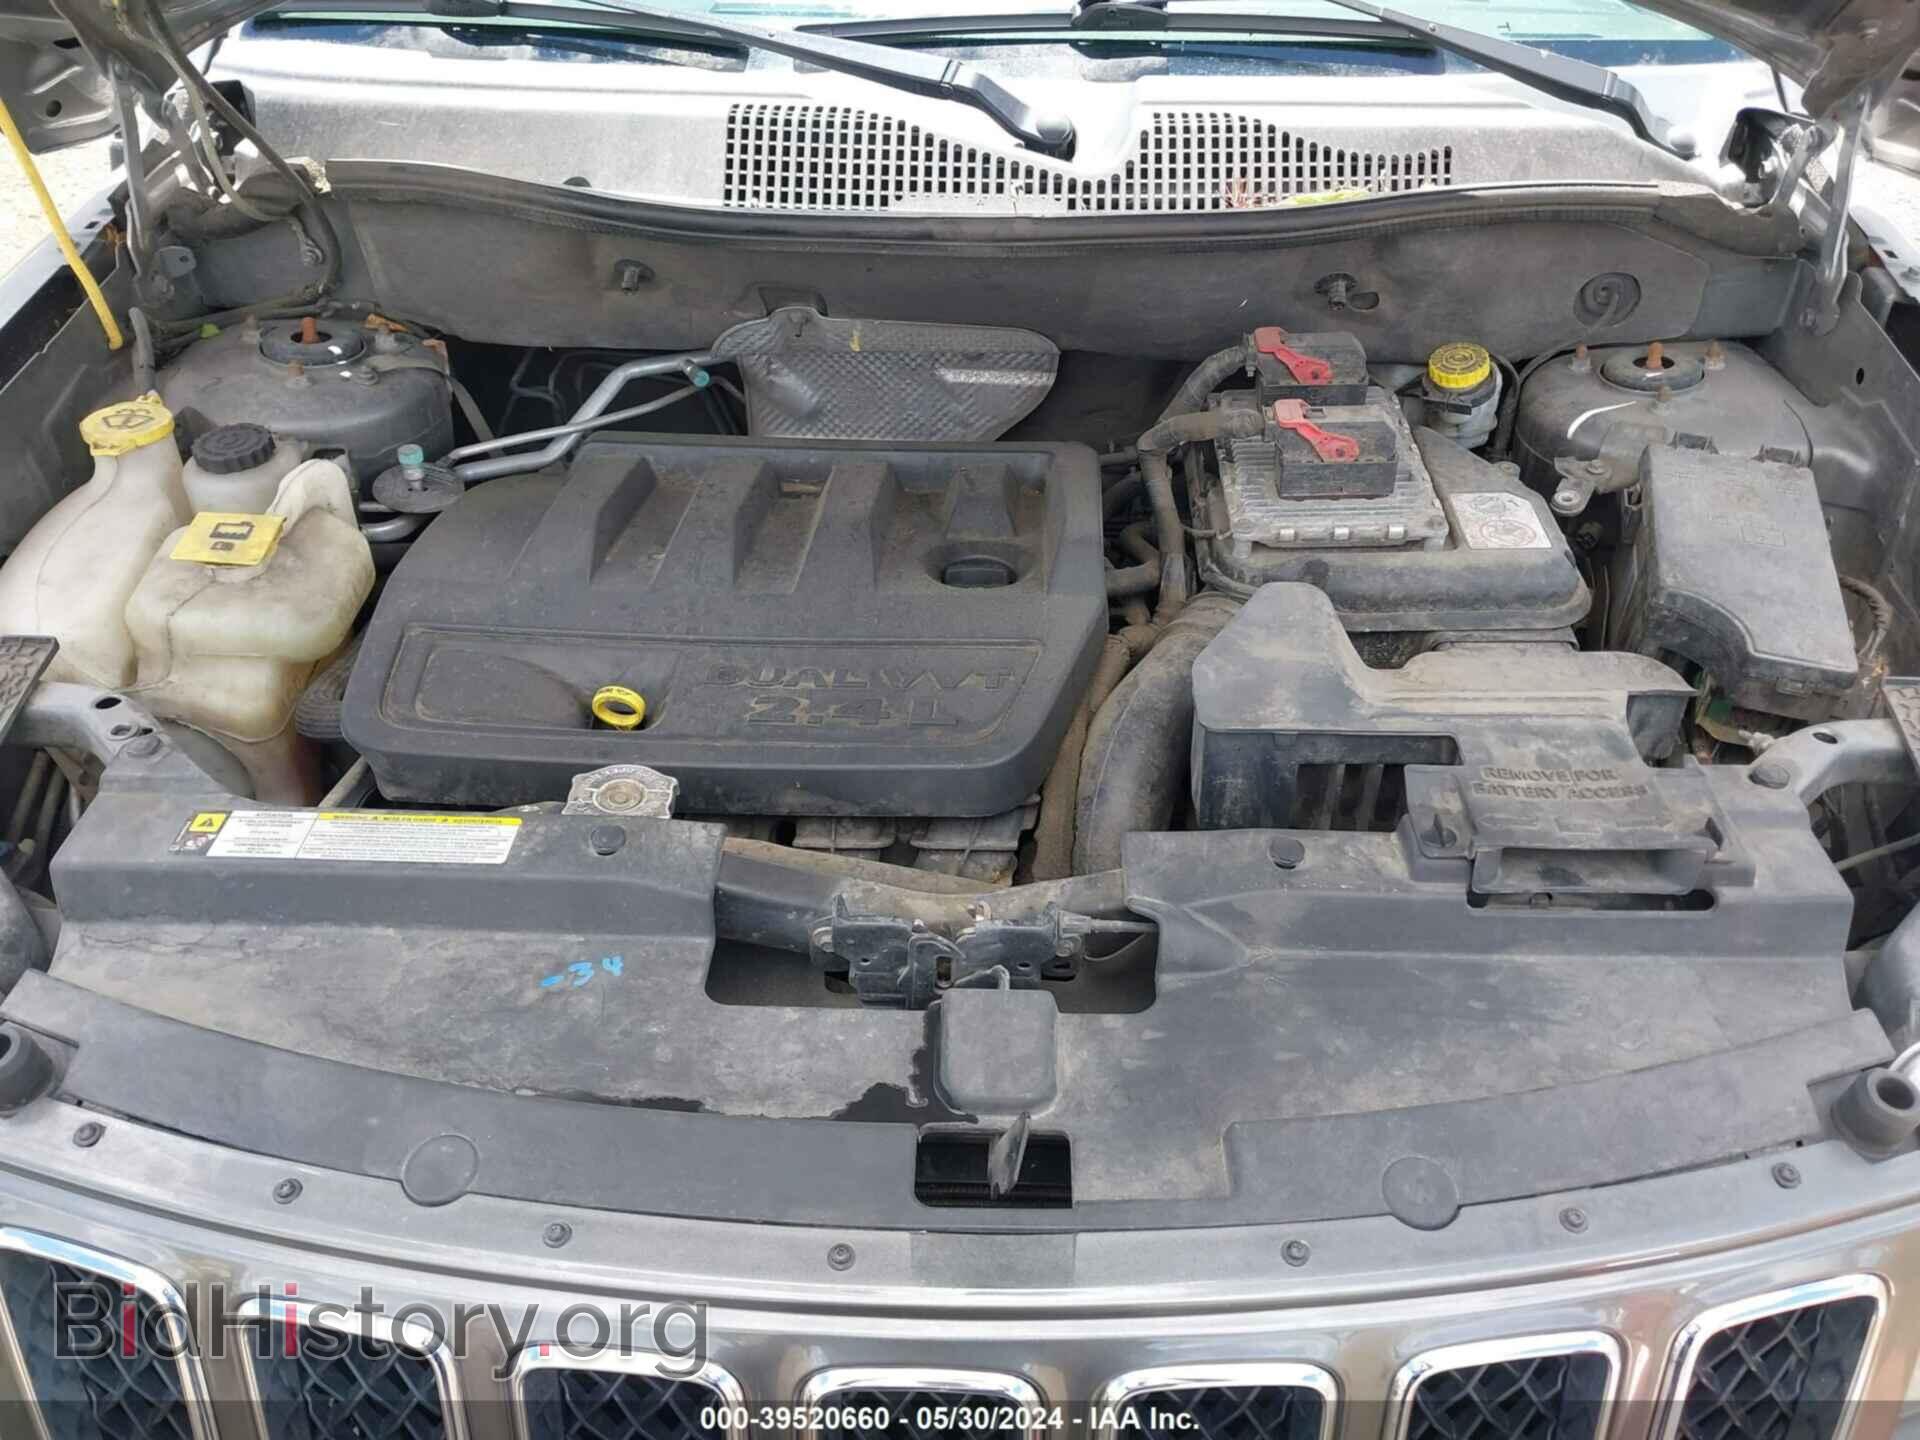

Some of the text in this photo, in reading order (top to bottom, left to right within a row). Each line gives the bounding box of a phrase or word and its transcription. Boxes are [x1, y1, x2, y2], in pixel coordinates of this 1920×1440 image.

[702, 663, 869, 689] DUAL
[1482, 767, 1619, 783] REMOVE FOR
[1473, 782, 1650, 800] BATTERY ACCESS
